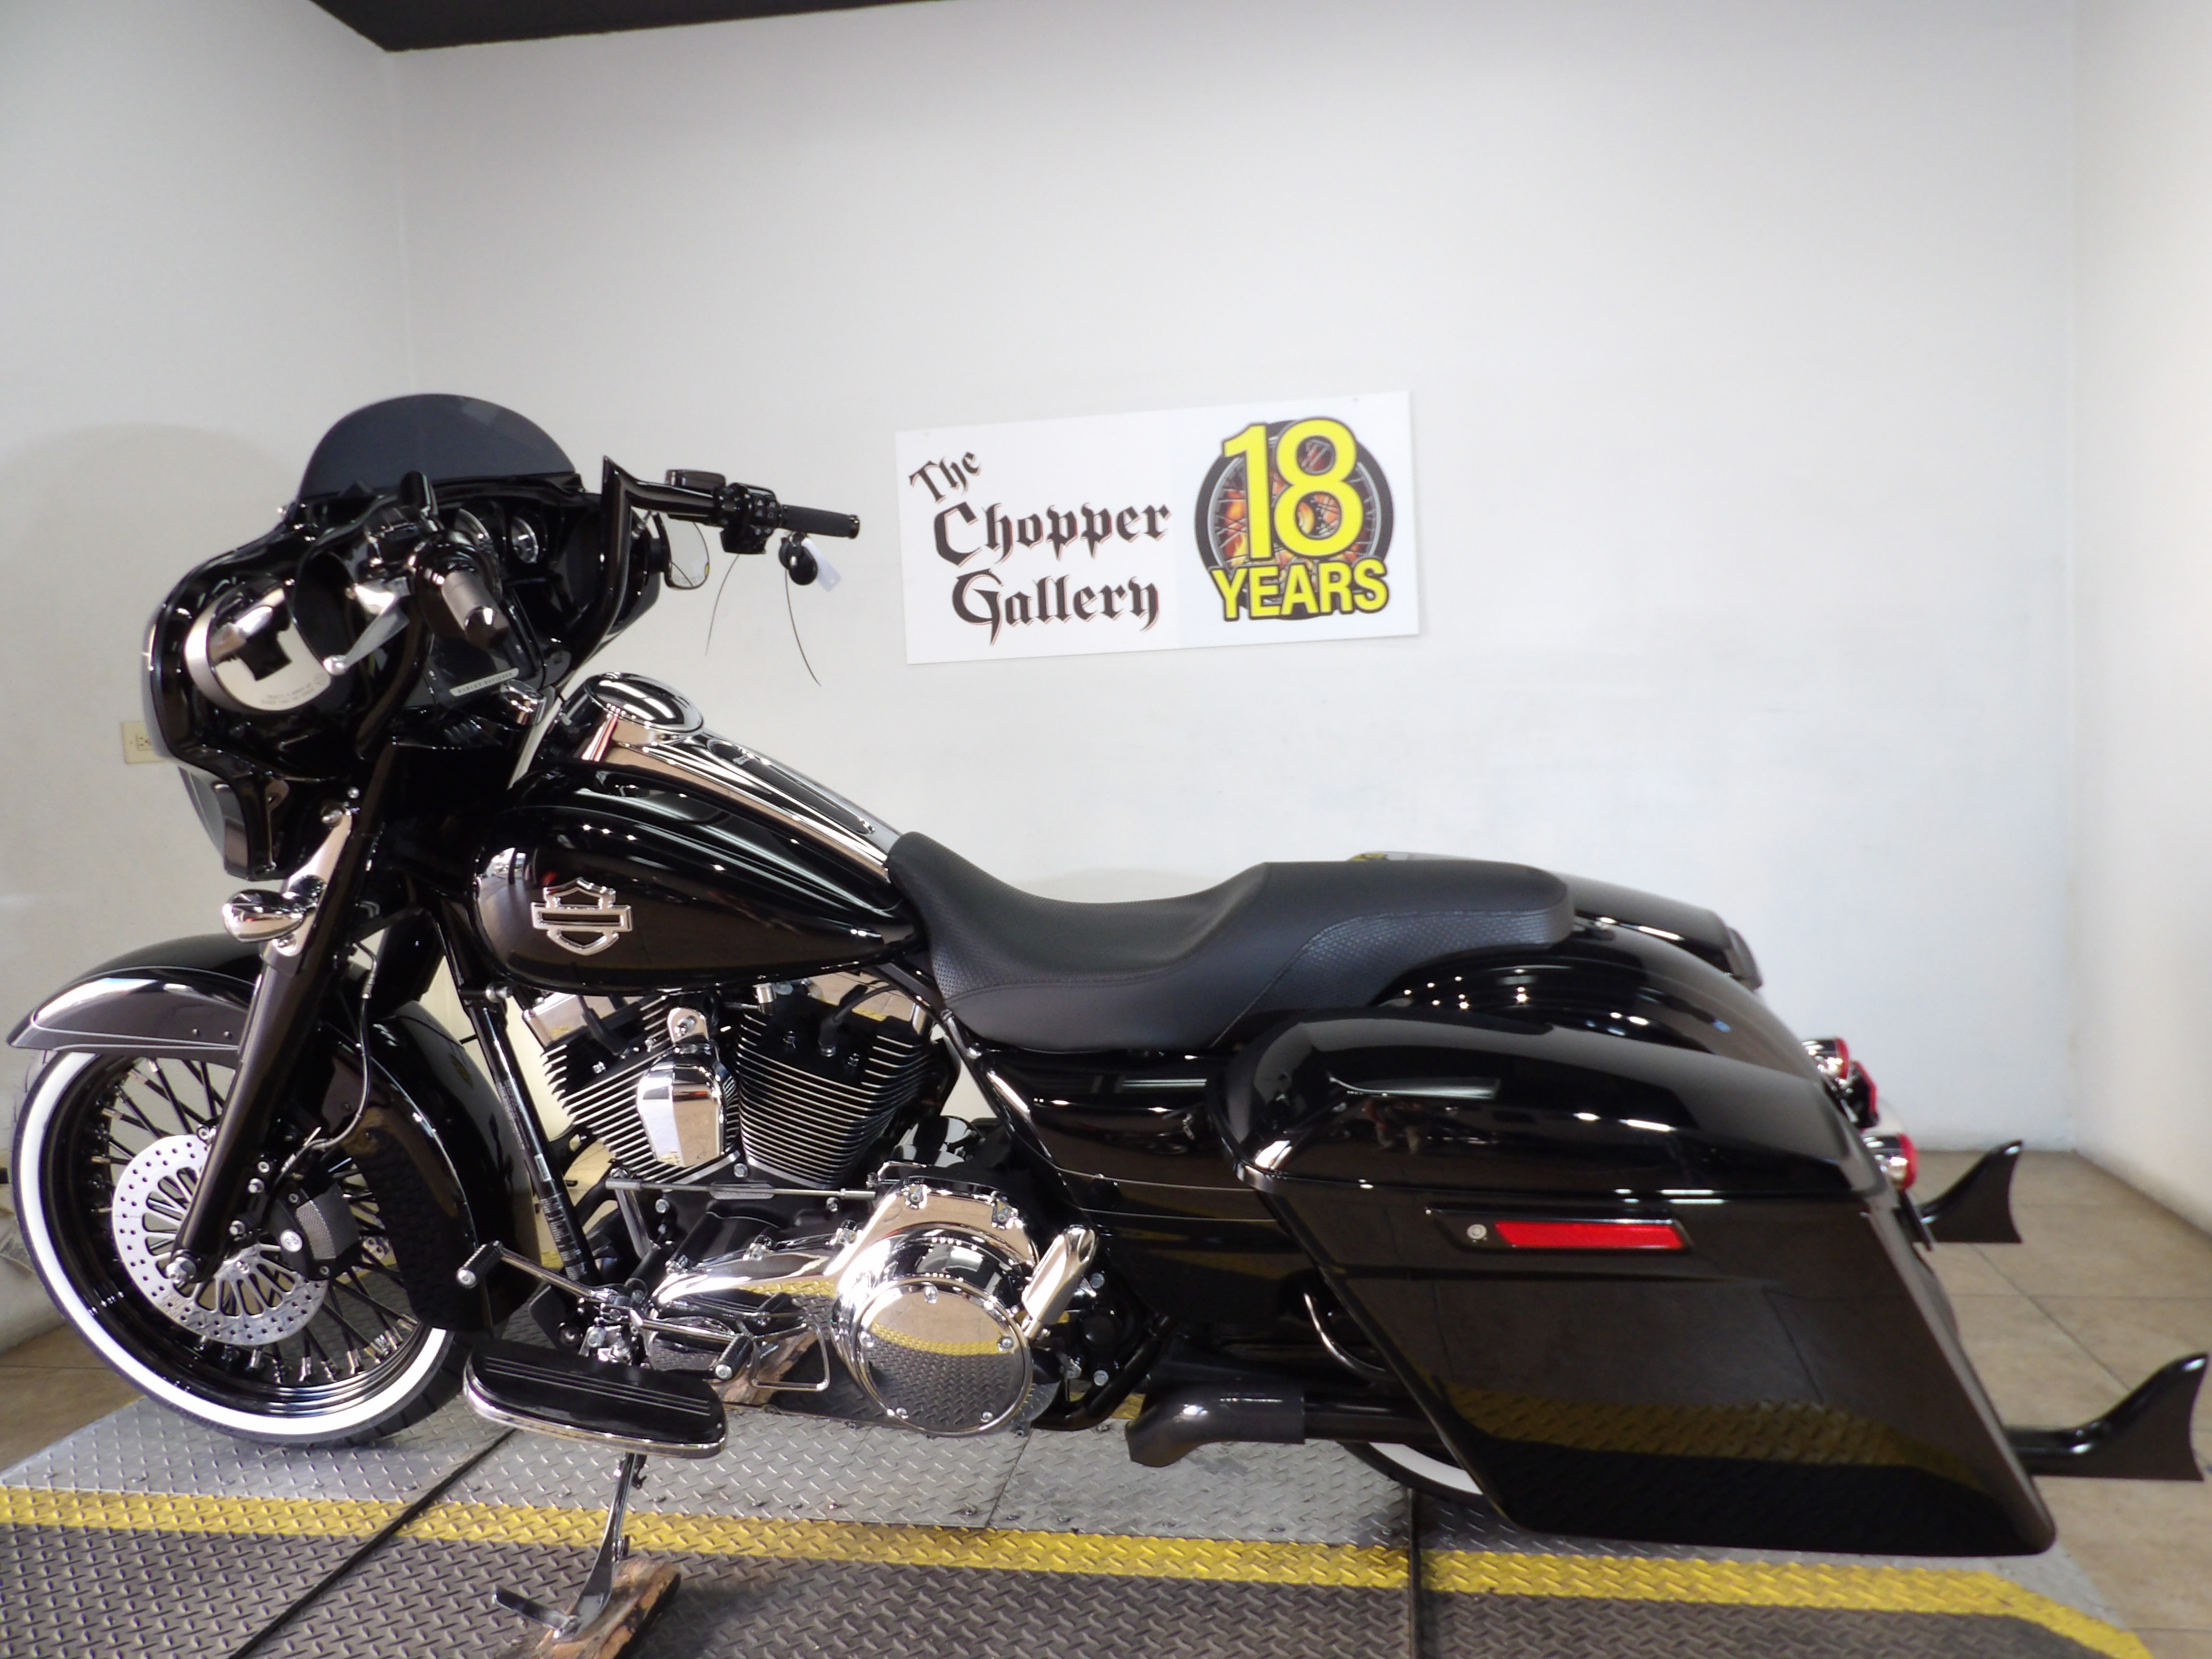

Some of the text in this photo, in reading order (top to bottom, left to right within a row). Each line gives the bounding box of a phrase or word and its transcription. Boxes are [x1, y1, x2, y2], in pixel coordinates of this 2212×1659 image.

[908, 451, 981, 503] The
[1222, 417, 1364, 559] 18
[934, 501, 1171, 566] Chopper
[952, 568, 1160, 645] Gallery
[1213, 557, 1388, 621] YEARS
